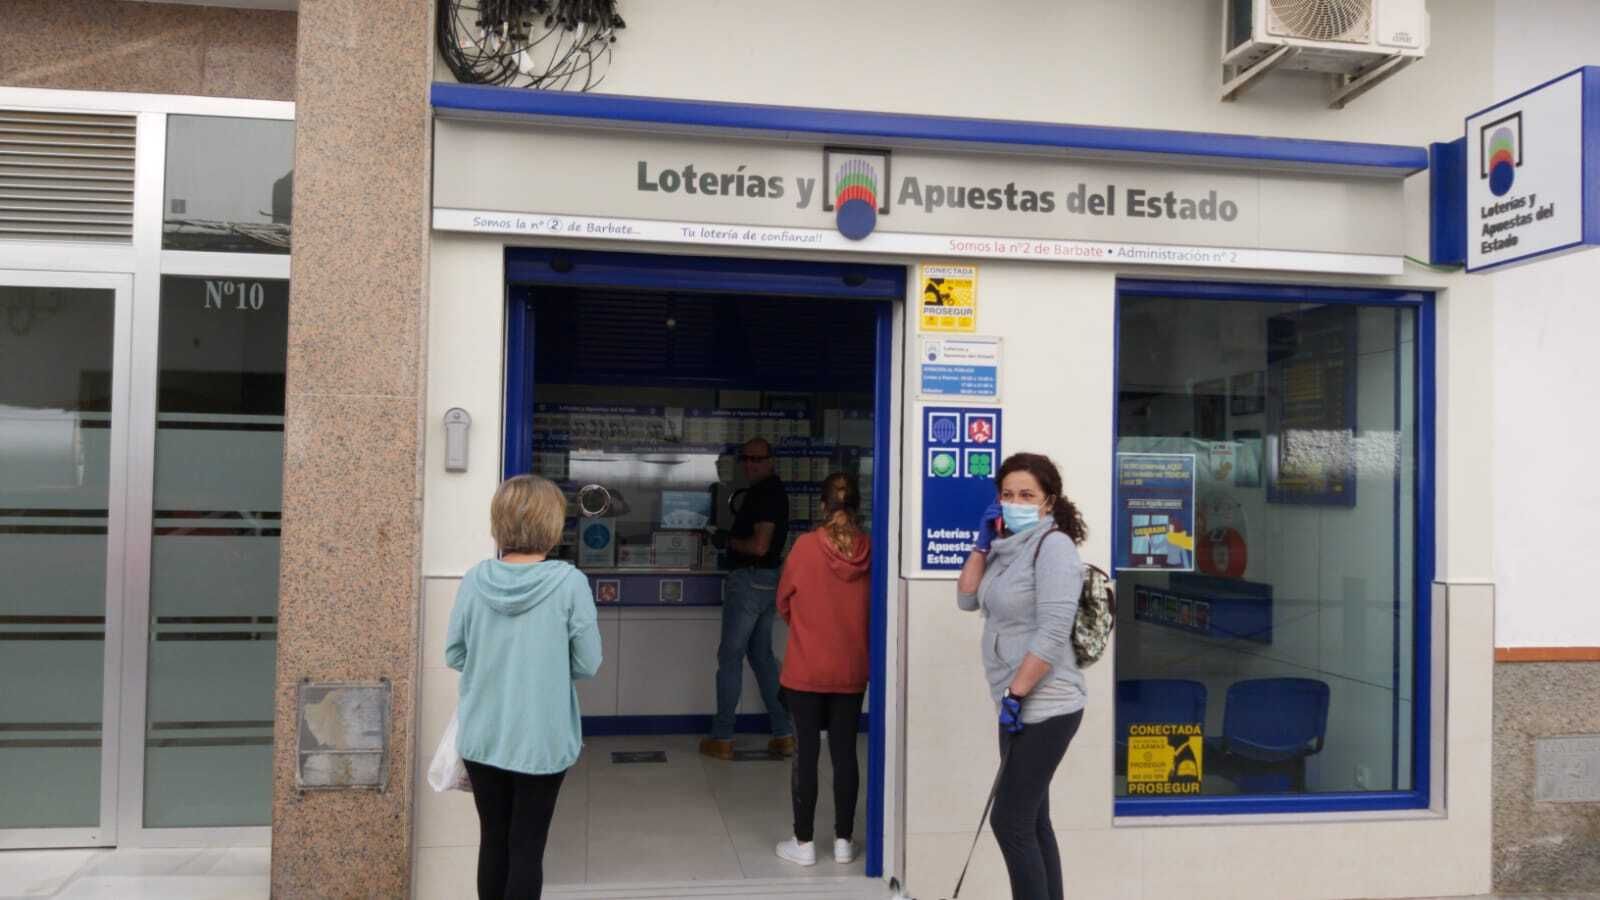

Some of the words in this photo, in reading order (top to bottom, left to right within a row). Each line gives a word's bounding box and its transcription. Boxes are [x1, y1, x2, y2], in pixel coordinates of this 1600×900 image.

[637, 160, 785, 199] Loterías
[796, 176, 816, 209] y
[897, 176, 1056, 213] Apuestas
[1066, 183, 1116, 217] del
[1126, 188, 1238, 222] Estado
[1481, 196, 1526, 219] Loterías
[1528, 193, 1536, 209] y
[473, 216, 511, 229] Somos
[516, 217, 526, 229] la
[568, 220, 581, 231] de
[1482, 212, 1533, 237] Apuestas
[1535, 203, 1555, 221] del
[682, 227, 695, 237] Tu
[700, 227, 738, 241] lotería
[742, 230, 757, 241] de
[949, 239, 991, 252] Somos
[995, 241, 1006, 253] la
[1034, 243, 1050, 255] de
[1054, 244, 1105, 257] Barbate
[1481, 233, 1519, 255] Estado
[1117, 247, 1209, 261] Administración
[1230, 251, 1238, 263] 2
[923, 307, 973, 316] PROSEGUR
[927, 528, 971, 539] Loterías
[972, 531, 980, 542] y
[927, 553, 964, 564] Estado
[1130, 725, 1201, 735] CONECTADA
[1128, 783, 1201, 794] PROSEGUR
